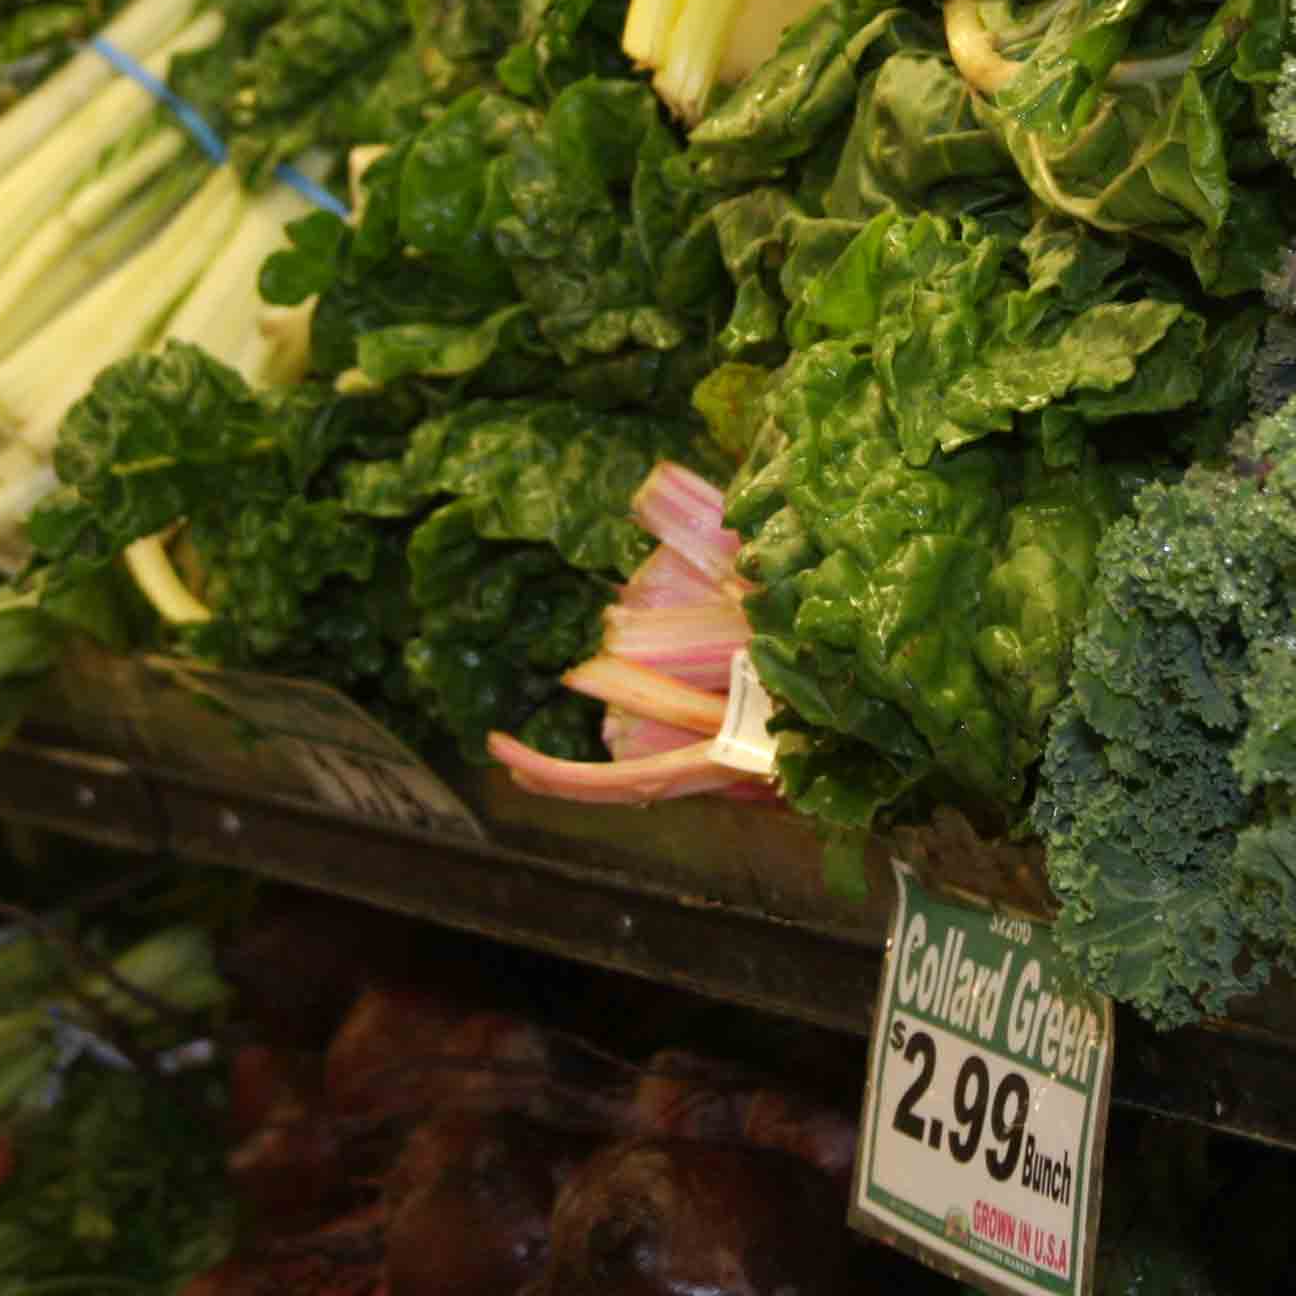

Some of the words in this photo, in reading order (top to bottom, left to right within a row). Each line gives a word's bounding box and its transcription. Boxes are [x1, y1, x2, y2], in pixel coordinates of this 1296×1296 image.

[899, 912, 1013, 1040] Collard
[1007, 959, 1097, 1083] Green
[890, 1020, 1030, 1182] $2.99
[1021, 1133, 1071, 1207] Bunch
[972, 1200, 1016, 1249] GROWN
[1017, 1220, 1033, 1253] IN
[1034, 1226, 1067, 1273] U.S.A
